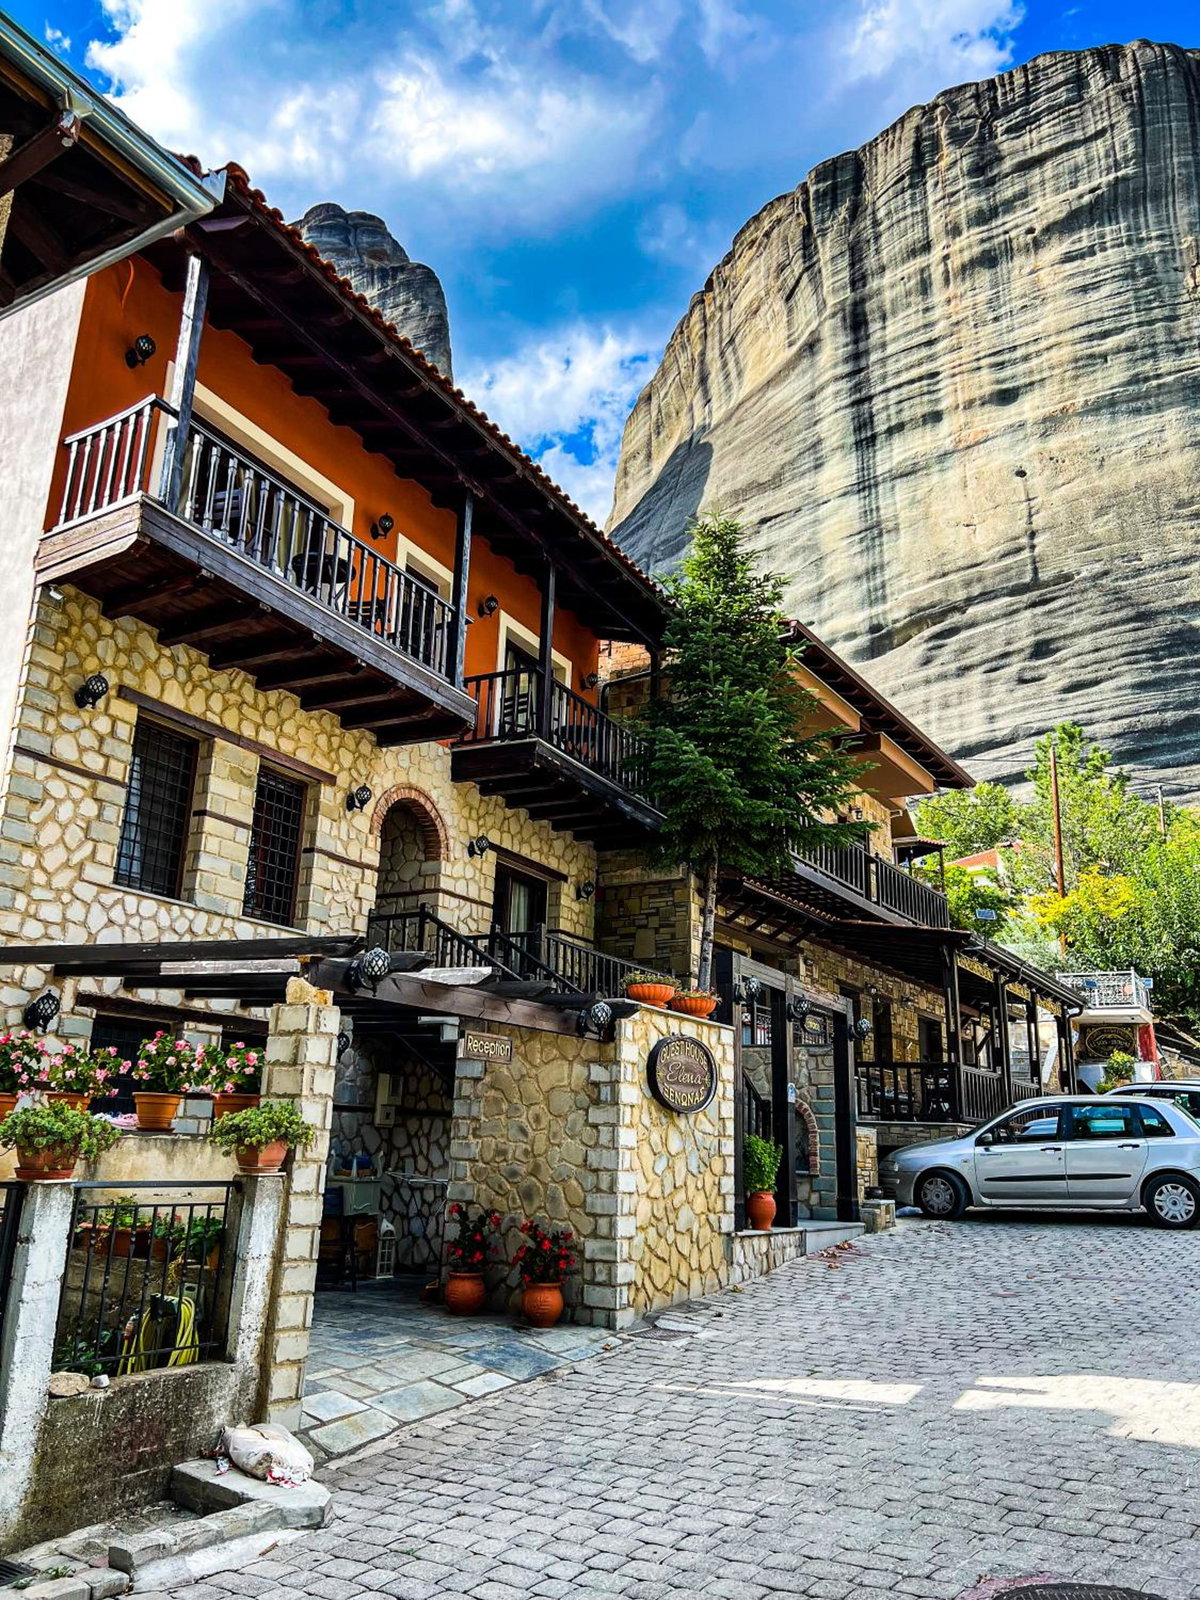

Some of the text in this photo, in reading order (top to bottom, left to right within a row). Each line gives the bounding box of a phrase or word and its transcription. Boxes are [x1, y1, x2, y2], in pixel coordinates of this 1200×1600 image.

[467, 1035, 511, 1058] Reception
[660, 1040, 708, 1071] GUEST HOUSE
[666, 1061, 702, 1085] Elena
[663, 1083, 705, 1106] ΞΕΝΩΝΑΣ
